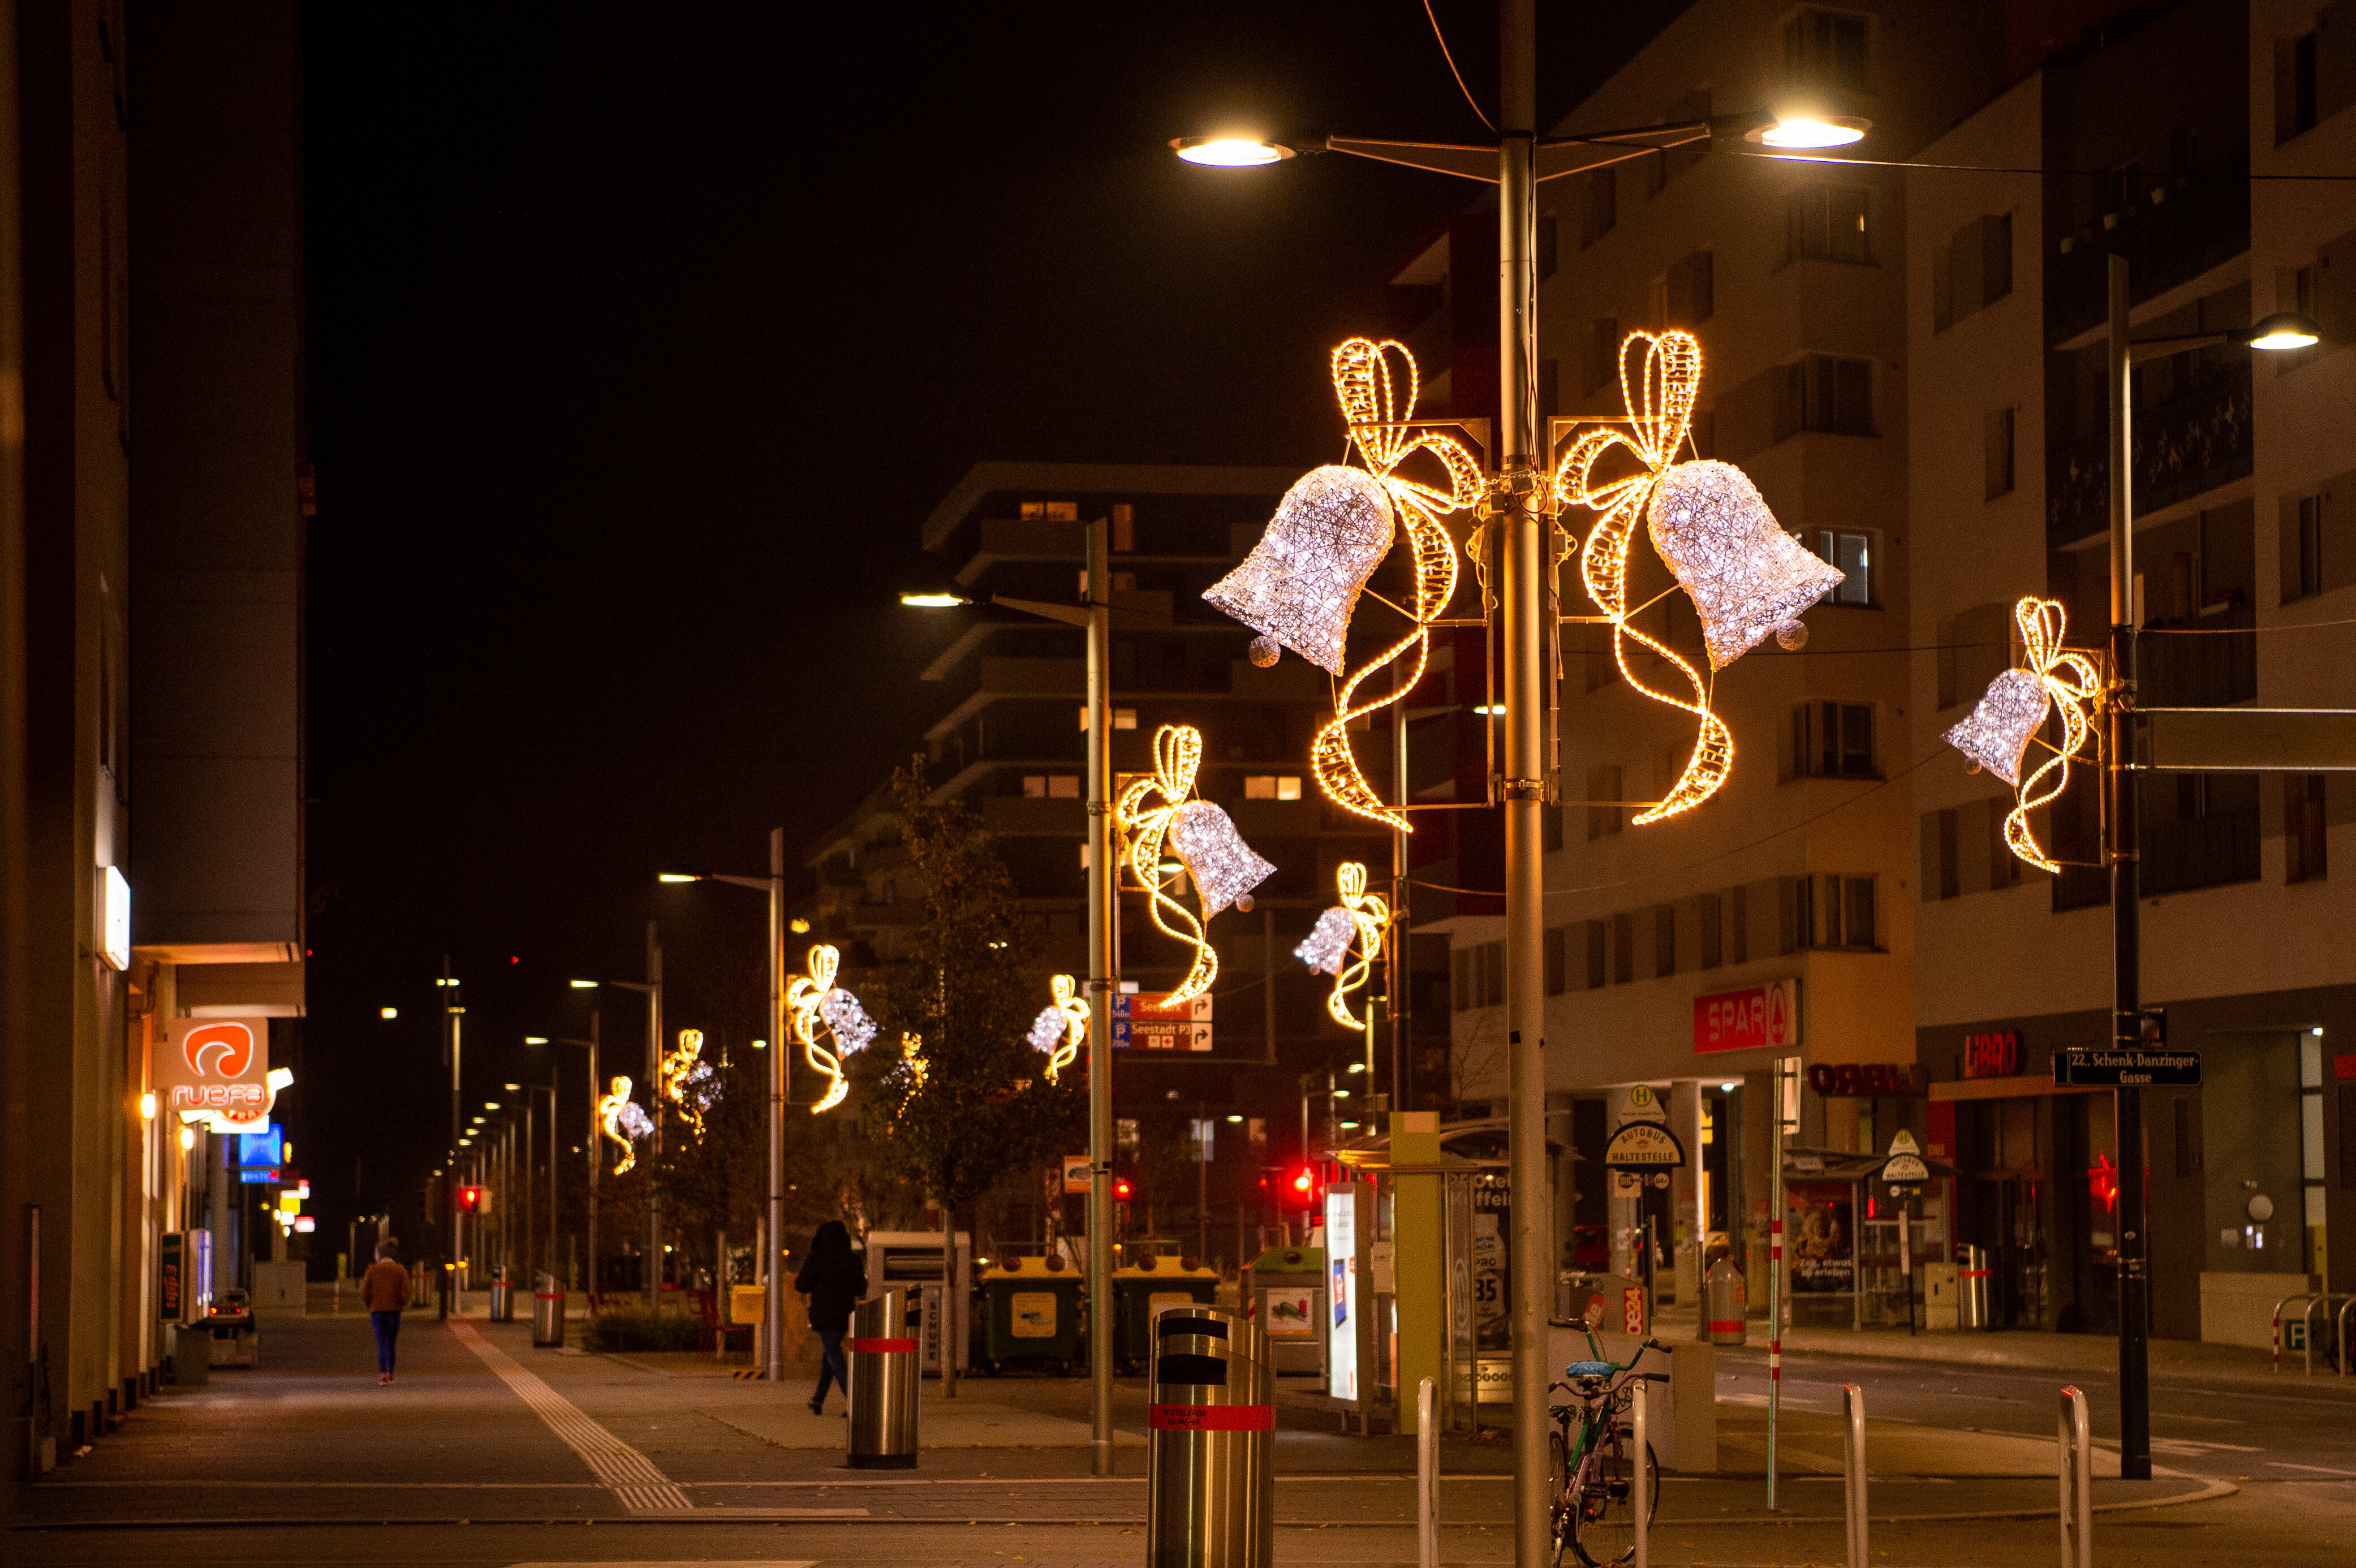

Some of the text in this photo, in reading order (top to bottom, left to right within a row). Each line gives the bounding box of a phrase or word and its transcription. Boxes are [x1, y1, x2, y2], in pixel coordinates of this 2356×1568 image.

[1140, 1002, 1182, 1013] Seepark
[1708, 995, 1765, 1042] SPAR
[1132, 1024, 1191, 1035] Seestadt P3
[2093, 1053, 2199, 1070] Schenk-Danzinger-
[2120, 1070, 2152, 1084] Gasse
[172, 1084, 264, 1106] ruefa
[1636, 1089, 1647, 1102] H
[1621, 1127, 1666, 1144] AUTOBUS
[1612, 1152, 1674, 1161] HALTESTELLE
[1475, 1278, 1497, 1302] 35
[1625, 1287, 1642, 1334] oe24
